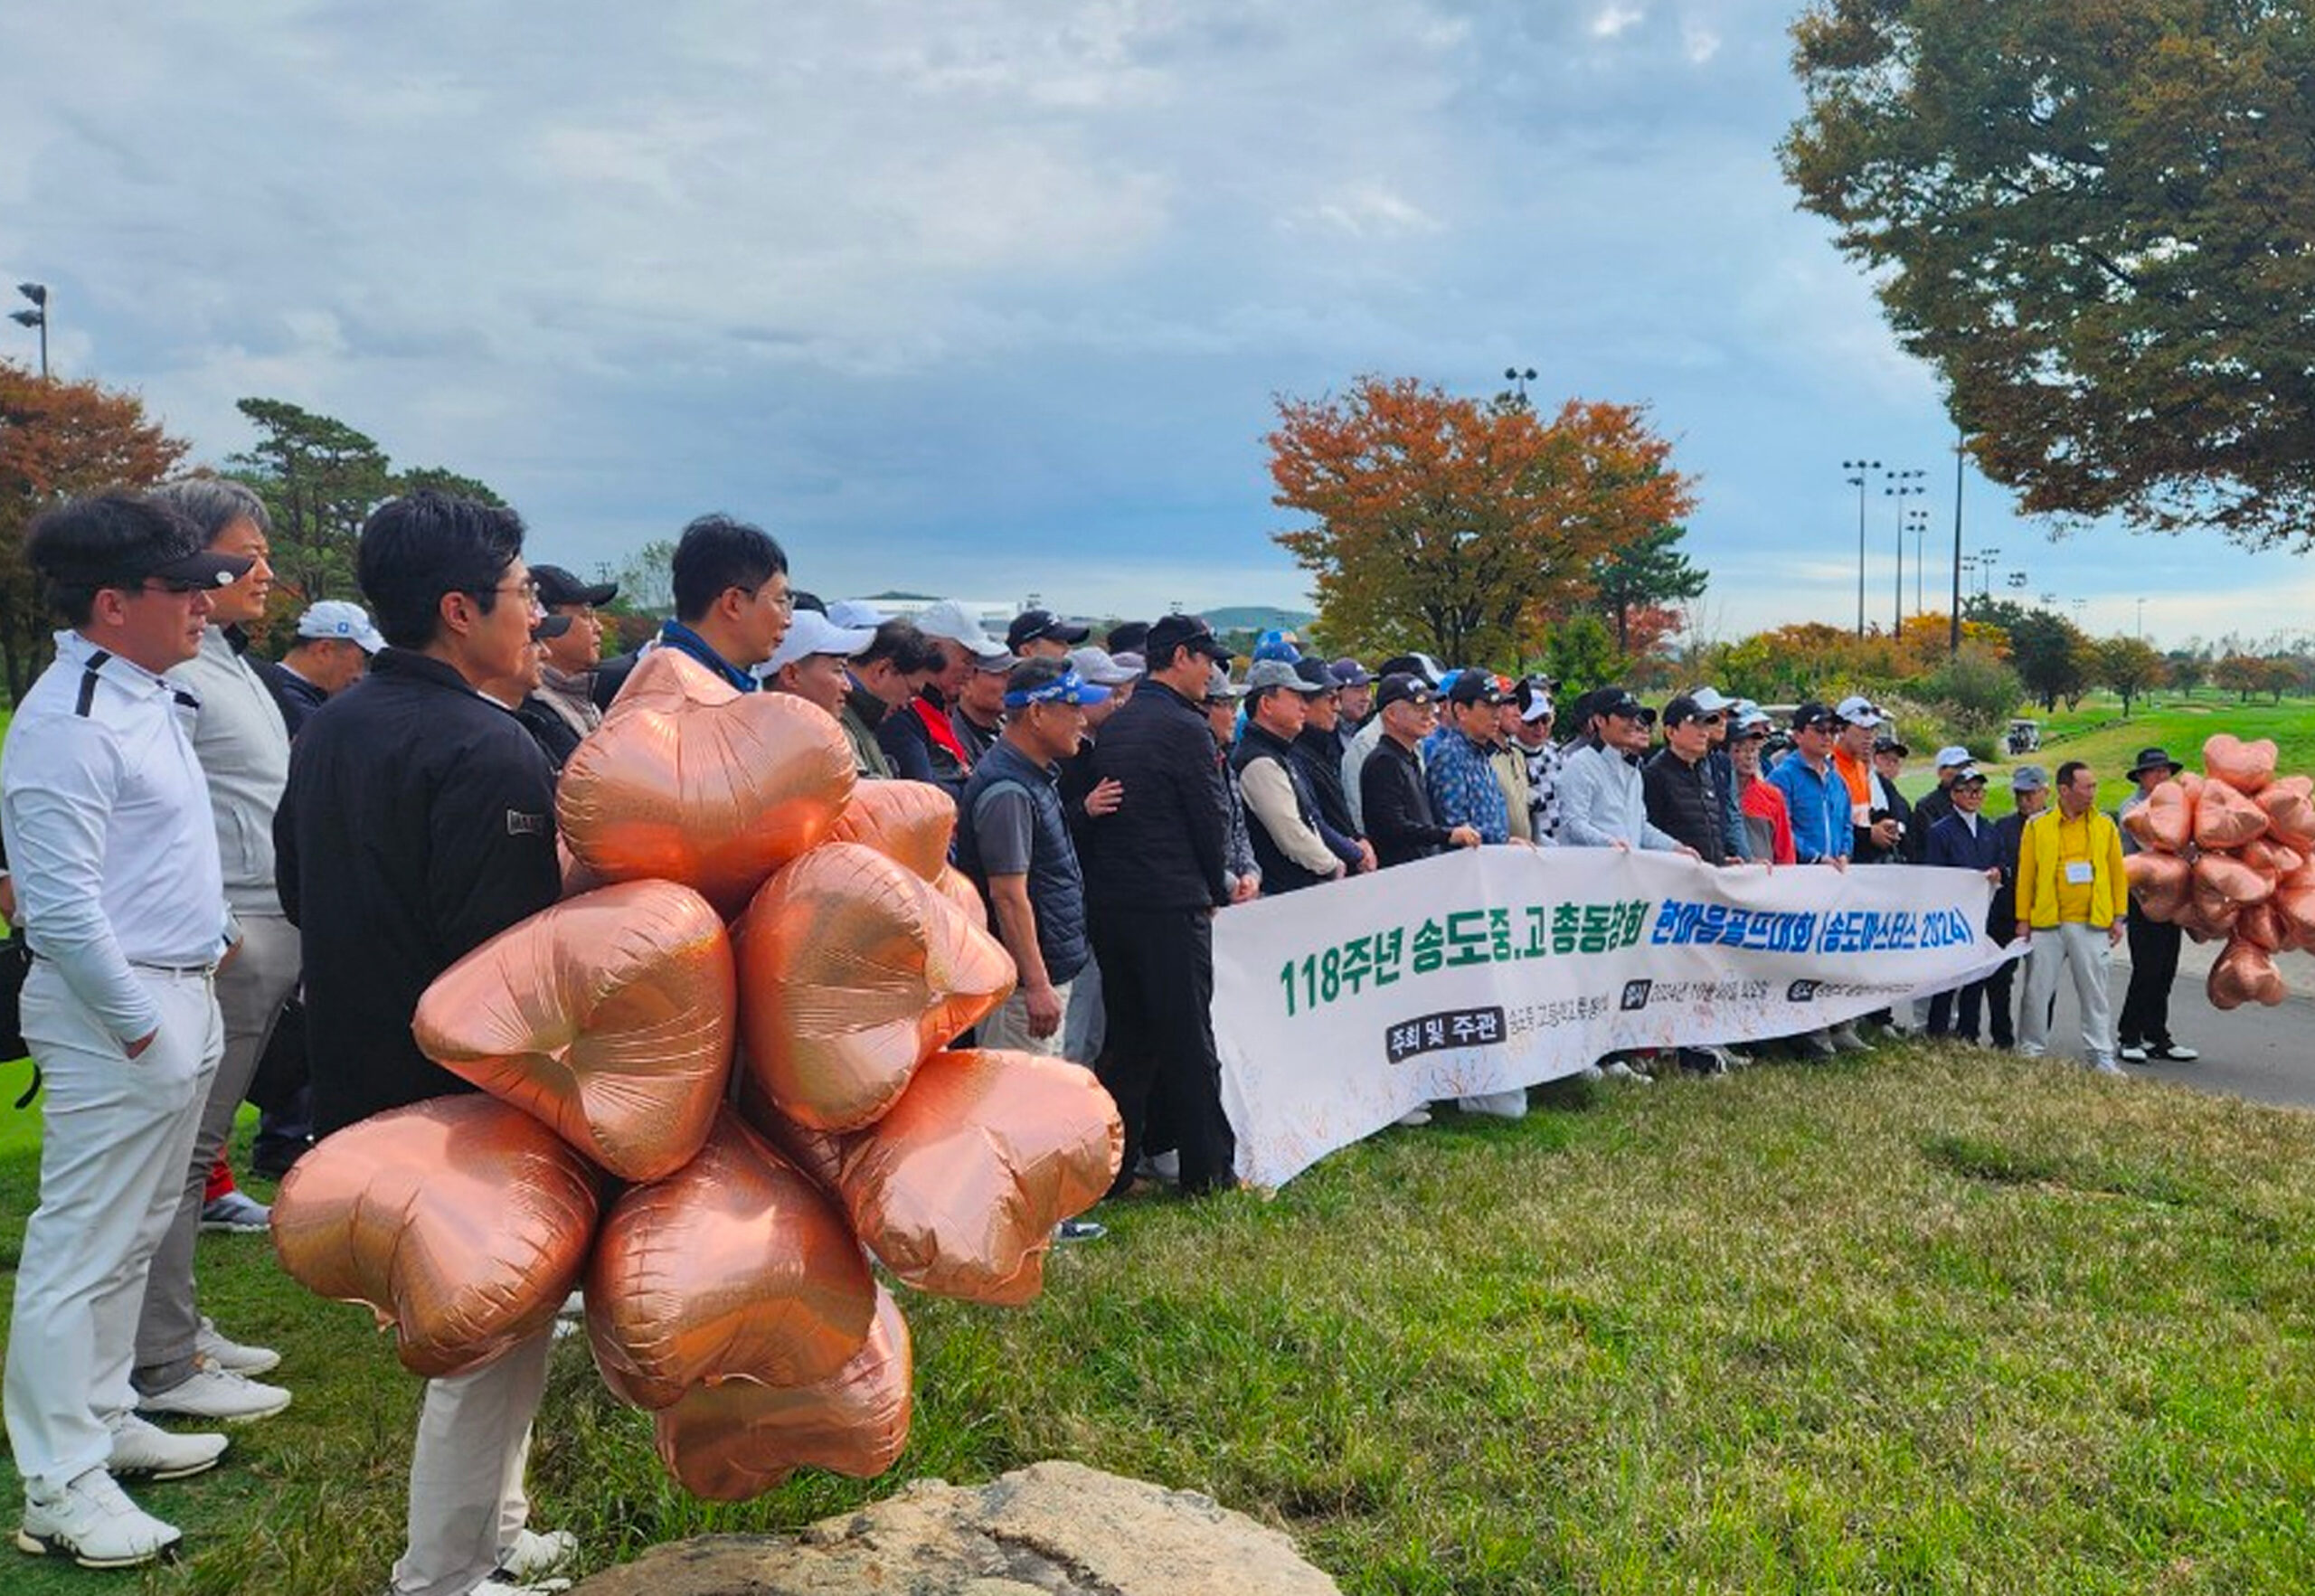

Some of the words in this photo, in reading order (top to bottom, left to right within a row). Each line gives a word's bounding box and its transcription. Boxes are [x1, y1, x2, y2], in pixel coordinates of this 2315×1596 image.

[1280, 927, 1403, 1016] 118주년
[1650, 898, 1816, 955] 한마음골프대회
[1425, 1017, 1445, 1046] 및
[1451, 1011, 1498, 1043] 주관
